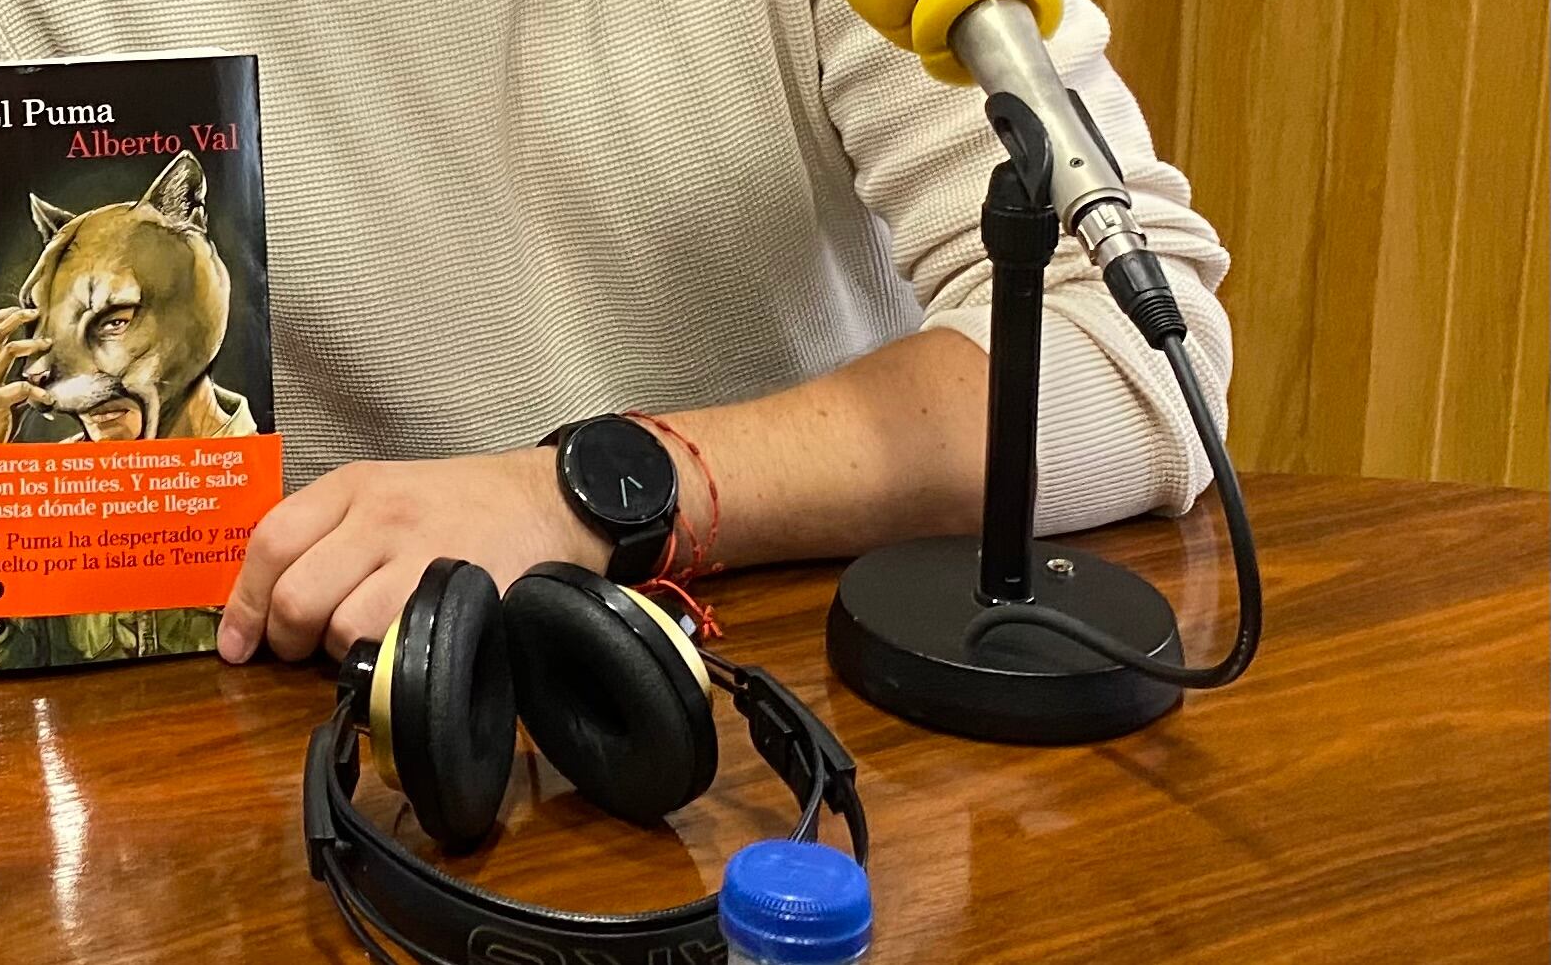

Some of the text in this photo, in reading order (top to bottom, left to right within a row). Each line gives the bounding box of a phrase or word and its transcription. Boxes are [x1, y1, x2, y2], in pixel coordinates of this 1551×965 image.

[21, 98, 115, 128] Puma
[65, 122, 239, 160] Alberto Val
[45, 458, 57, 472] a
[61, 456, 94, 471] sus
[98, 450, 186, 470] víctimas.
[190, 448, 244, 470] Juega
[19, 476, 48, 496] los
[52, 475, 124, 495] límites.
[130, 474, 146, 491] Y
[148, 470, 201, 491] nadie
[205, 469, 248, 488] sabe
[38, 497, 97, 517] dónde
[101, 496, 160, 520] puede
[164, 494, 220, 516] llegar.
[6, 532, 62, 551] Puma
[68, 530, 92, 549] ha
[97, 525, 203, 550] despertado
[207, 527, 219, 544] y
[43, 556, 77, 576] por
[82, 552, 100, 570] la
[105, 550, 137, 570] isla
[142, 548, 165, 567] de
[171, 544, 247, 566] Tenerife
